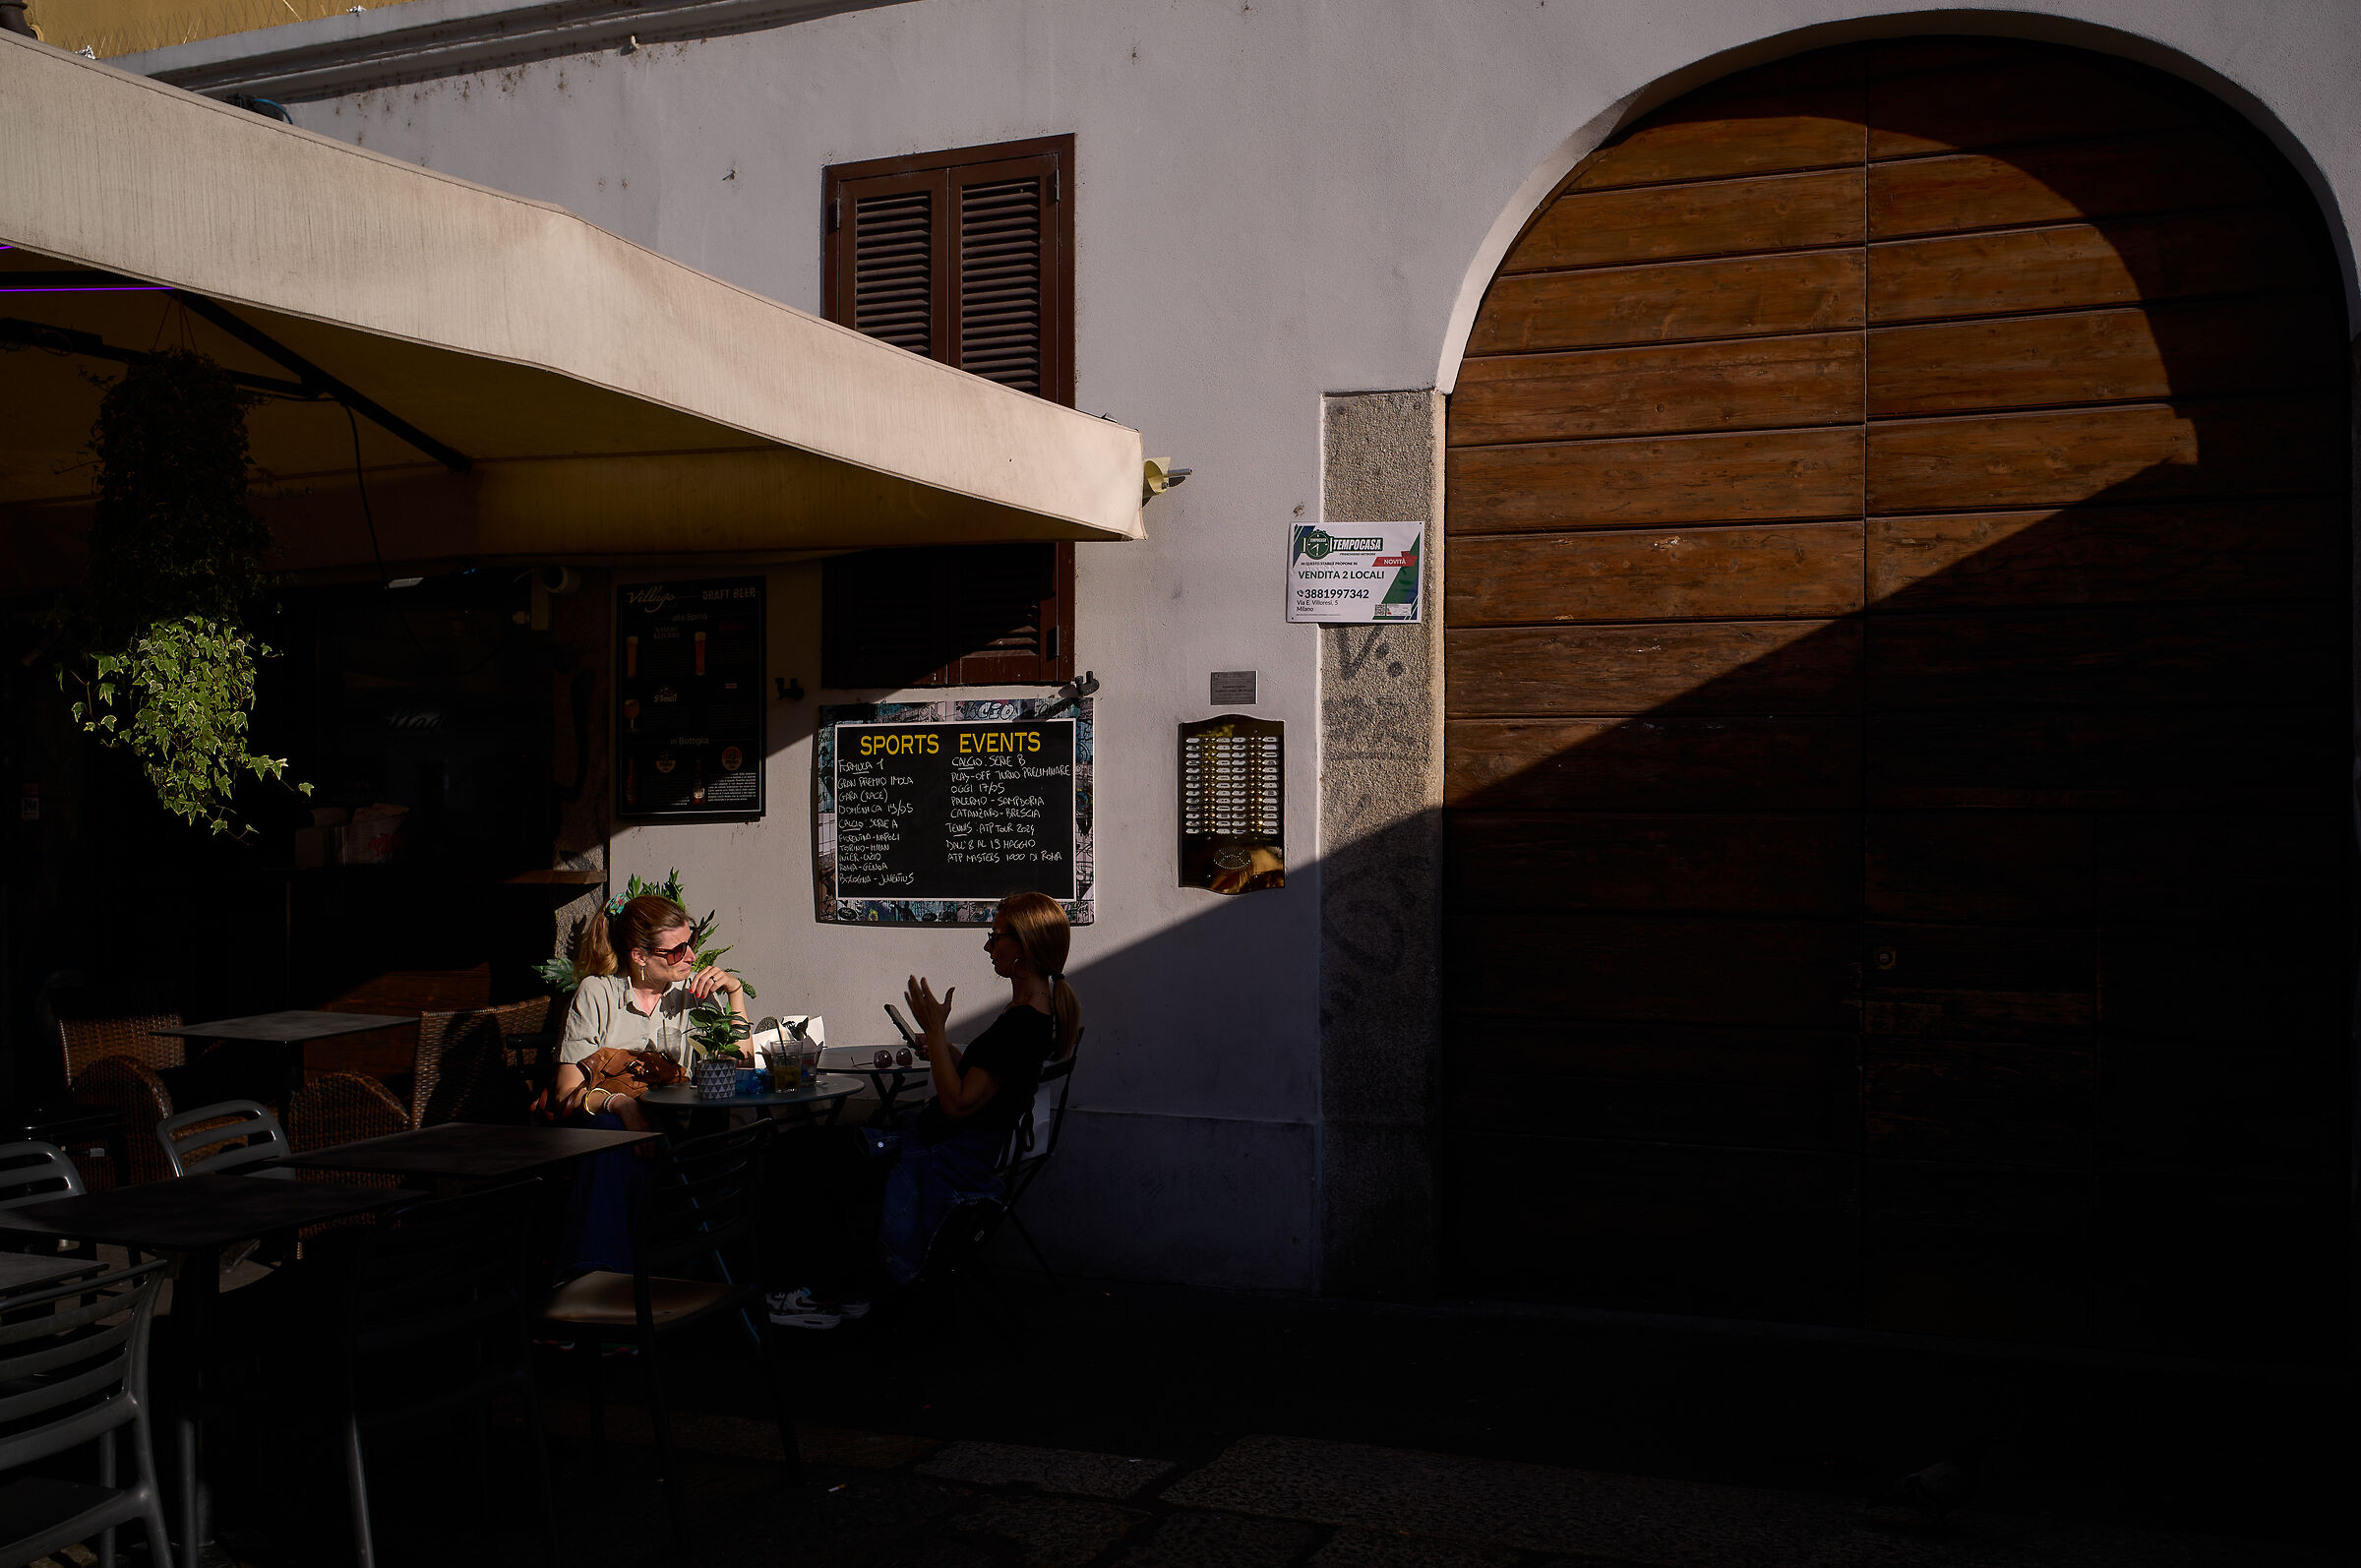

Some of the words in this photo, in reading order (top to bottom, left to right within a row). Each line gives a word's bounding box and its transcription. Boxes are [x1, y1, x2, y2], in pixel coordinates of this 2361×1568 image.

[1333, 539, 1381, 551] TEMPOCASA
[1299, 571, 1341, 579] VENDITA
[1343, 571, 1349, 579] 2
[1351, 571, 1385, 579] LOCALI
[732, 587, 756, 598] BEER
[1304, 589, 1369, 599] 3881997342
[860, 734, 939, 755] SPORTS
[959, 732, 1041, 754] EVENTS
[838, 759, 873, 772] FORMULA
[877, 758, 883, 769] 1
[990, 755, 1013, 766] SERIE
[1017, 754, 1026, 766] B
[995, 770, 1021, 779] TURNO
[1022, 765, 1071, 778] PRELIMINARE
[838, 777, 856, 789] GRAN
[859, 777, 887, 787] PREMIO
[890, 776, 914, 785] IMOLA
[950, 784, 973, 793] OGGI
[979, 782, 1005, 794] 17/05
[839, 791, 859, 802] GARA
[860, 788, 888, 803] (RACE)
[950, 796, 988, 806] PALERMO
[997, 796, 1045, 806] SAMPDORIA
[891, 819, 898, 828] A
[1002, 839, 1036, 849] MAGGIO
[947, 853, 964, 863] ATP
[966, 852, 1000, 863] MASTERS
[1041, 850, 1062, 862] ROMA
